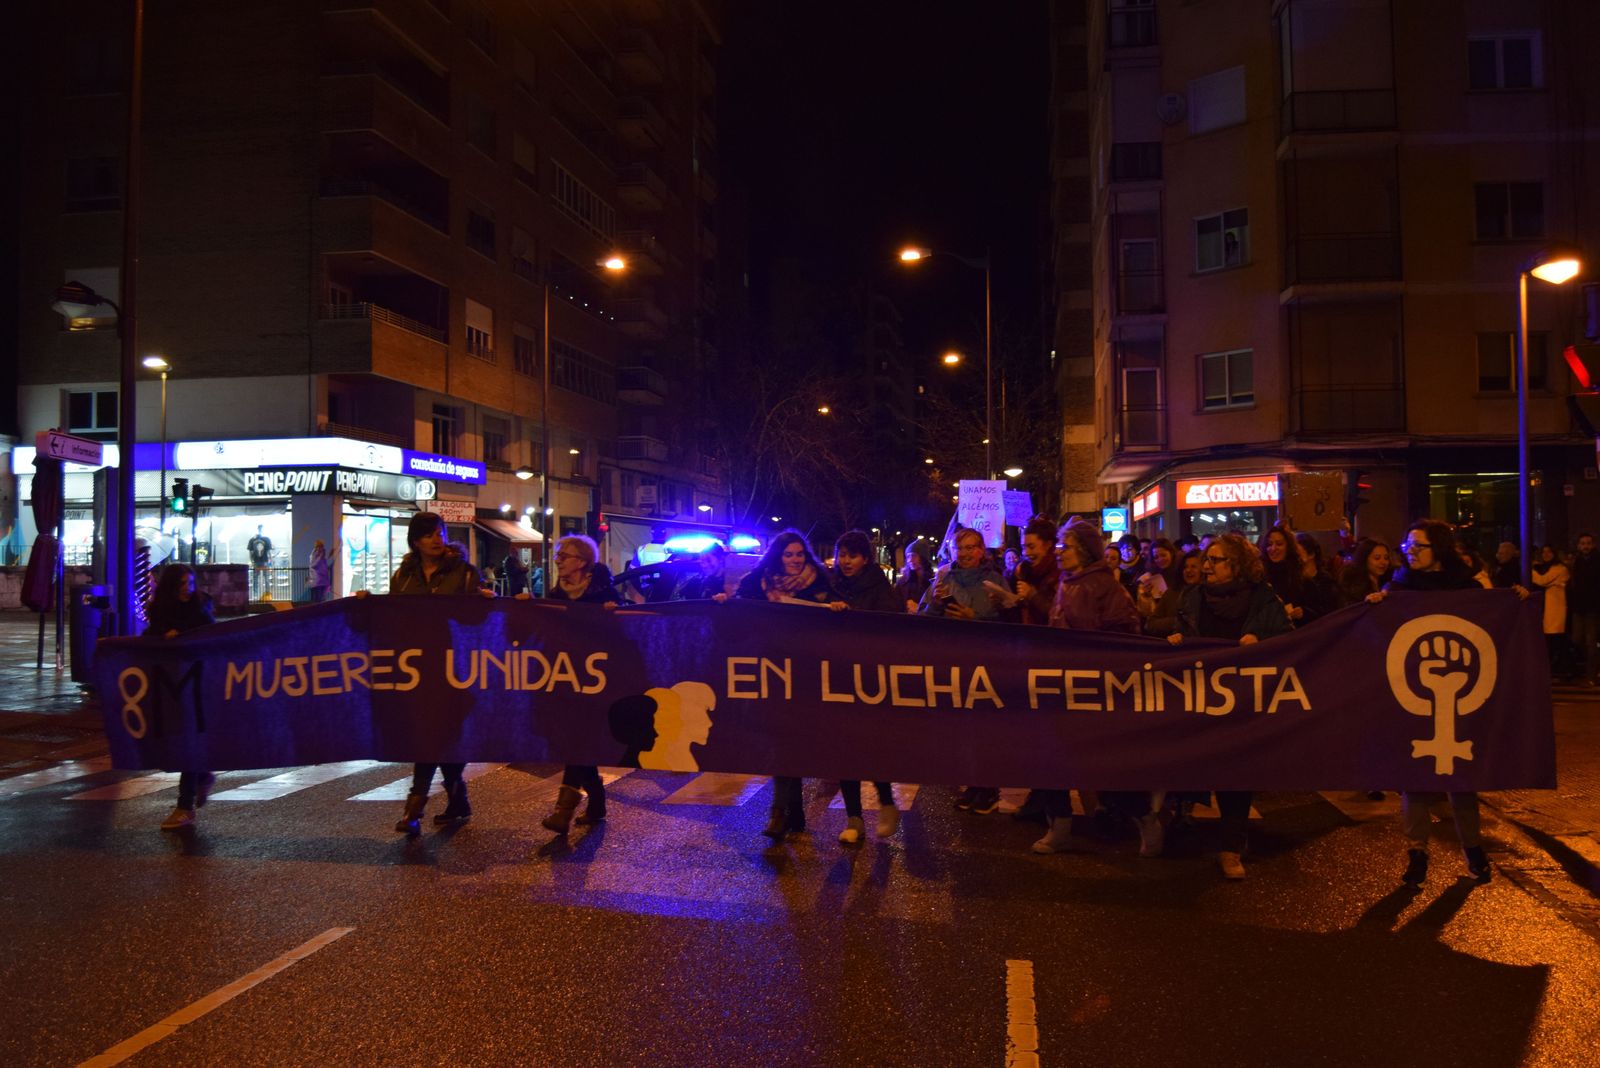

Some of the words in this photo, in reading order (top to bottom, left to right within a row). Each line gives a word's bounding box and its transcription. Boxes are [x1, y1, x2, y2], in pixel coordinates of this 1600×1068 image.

[446, 462, 455, 474] de
[456, 466, 479, 479] seguros
[244, 470, 332, 493] PENGPOINT
[336, 470, 379, 494] PENGPOINT
[963, 486, 997, 494] UNAMOS
[971, 521, 991, 531] VOZ
[118, 658, 205, 740] 8M
[224, 649, 423, 701] MUJERES
[727, 656, 792, 699] EN
[820, 659, 1005, 709] LUCHA
